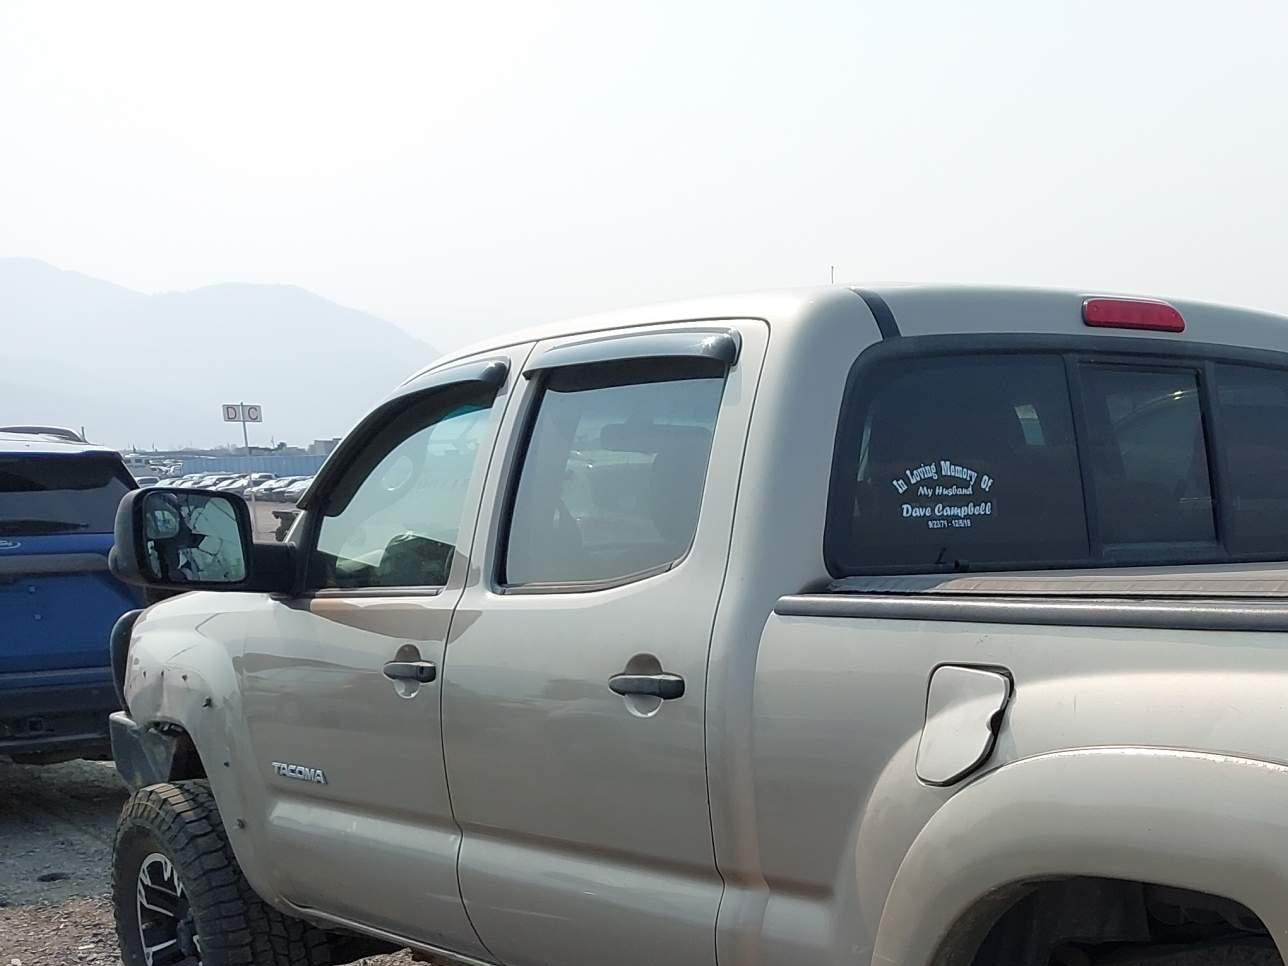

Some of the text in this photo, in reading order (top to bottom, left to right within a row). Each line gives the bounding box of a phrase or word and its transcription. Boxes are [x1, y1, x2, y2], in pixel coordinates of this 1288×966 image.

[226, 406, 259, 421] D C
[893, 460, 994, 494] In Loving Memory Of
[917, 485, 973, 498] My Husband
[902, 502, 992, 518] Dave Campbell
[271, 761, 325, 784] TACOMA
